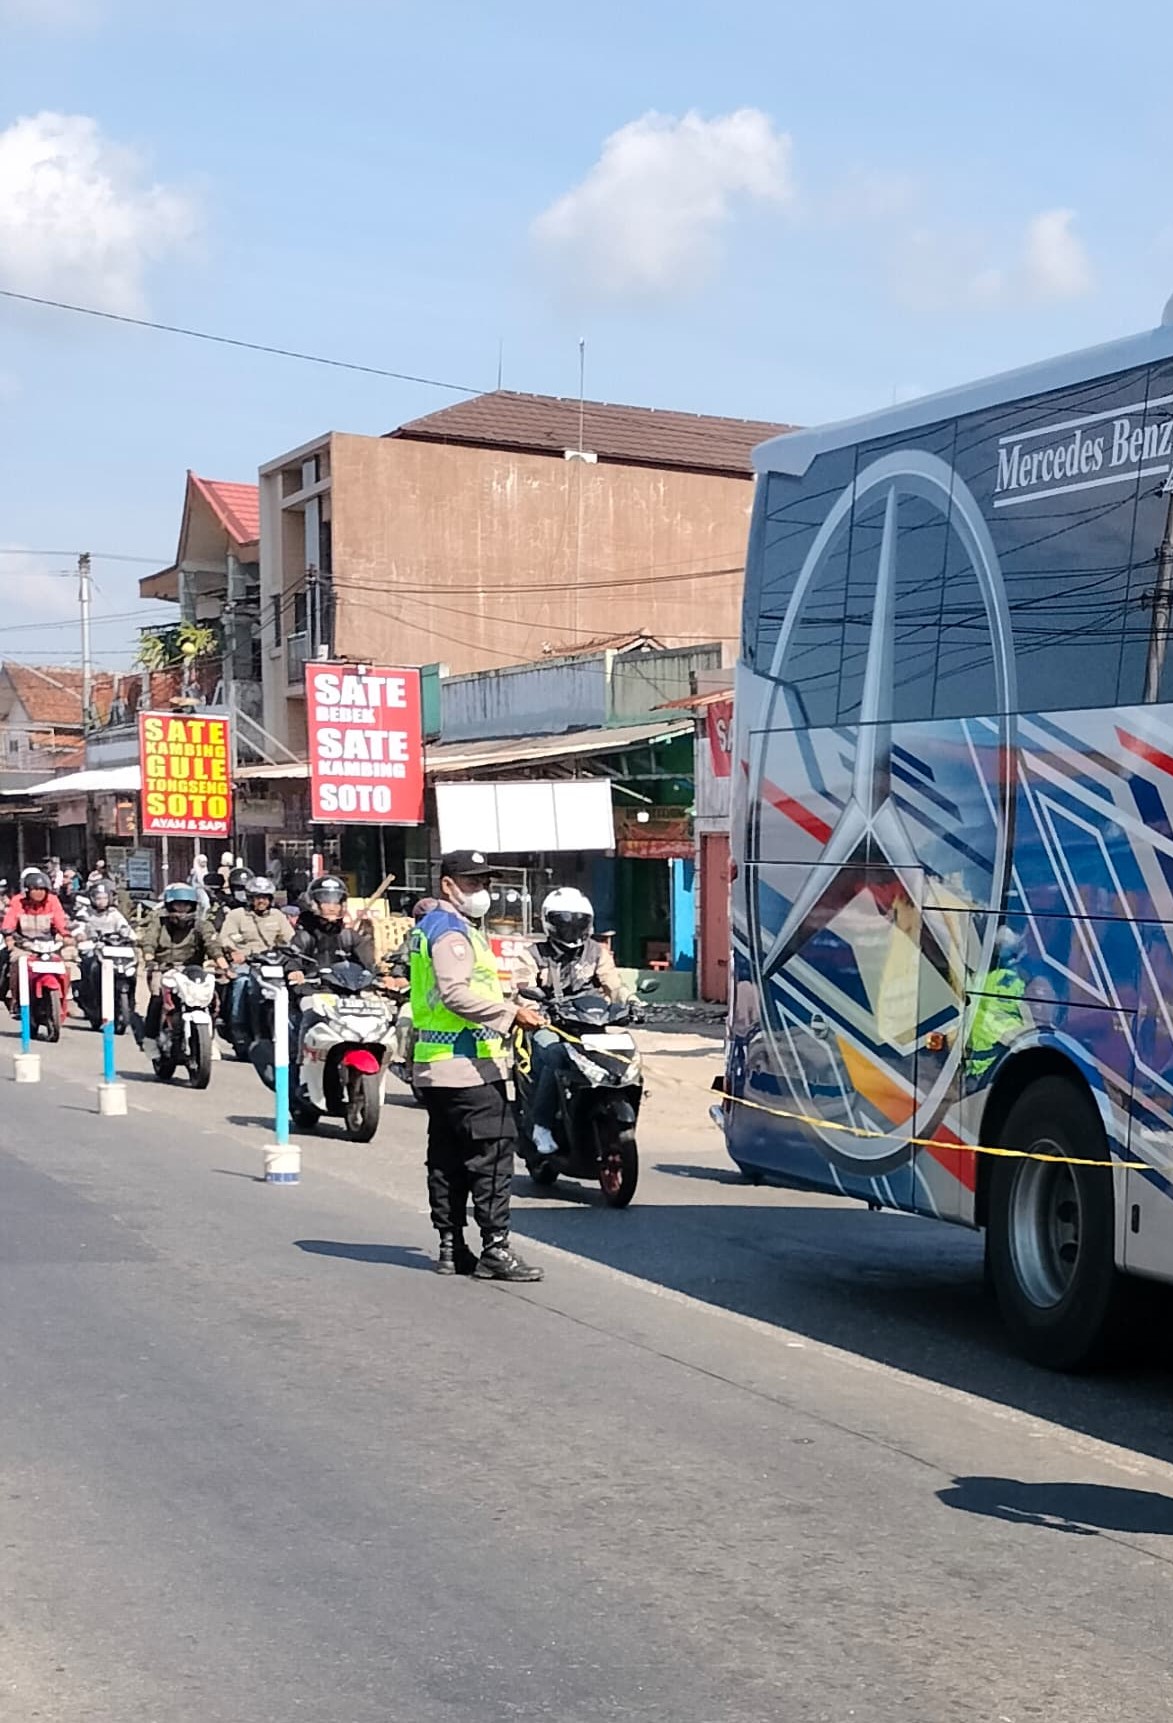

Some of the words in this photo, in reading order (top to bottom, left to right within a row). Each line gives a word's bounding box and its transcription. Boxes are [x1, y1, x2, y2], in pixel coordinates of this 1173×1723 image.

[994, 429, 1105, 492] Mercedes
[315, 673, 407, 708] SATE
[145, 718, 225, 745] SATE
[316, 727, 409, 761] SATE
[146, 741, 226, 758] KAMBING
[146, 755, 228, 781] GULE
[318, 760, 406, 779] KAMBING
[146, 778, 228, 795] TONGSENG
[319, 783, 392, 814] SOTO
[147, 792, 228, 819] SOTO
[151, 818, 186, 830] AYAM
[188, 820, 198, 830] &
